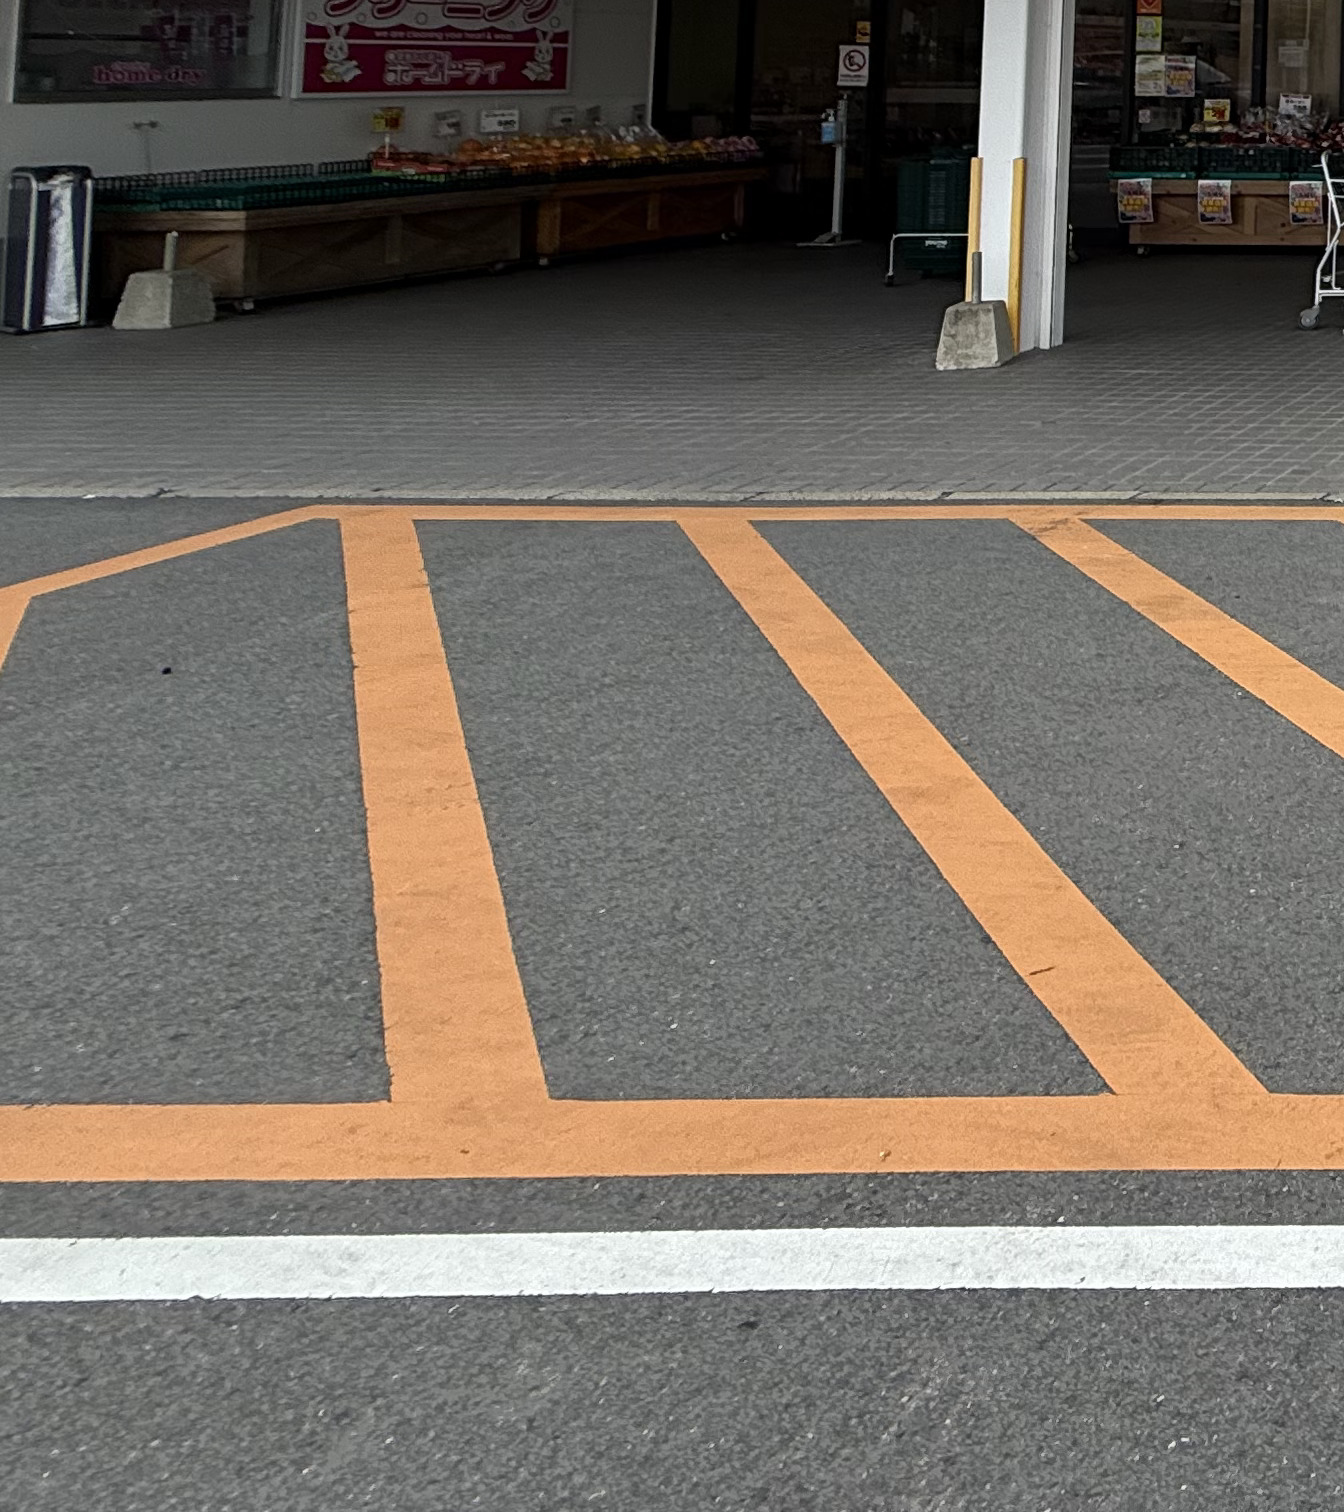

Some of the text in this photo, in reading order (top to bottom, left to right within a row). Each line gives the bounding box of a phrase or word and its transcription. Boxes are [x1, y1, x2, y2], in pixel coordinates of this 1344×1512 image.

[385, 54, 505, 85] ホームドライ
